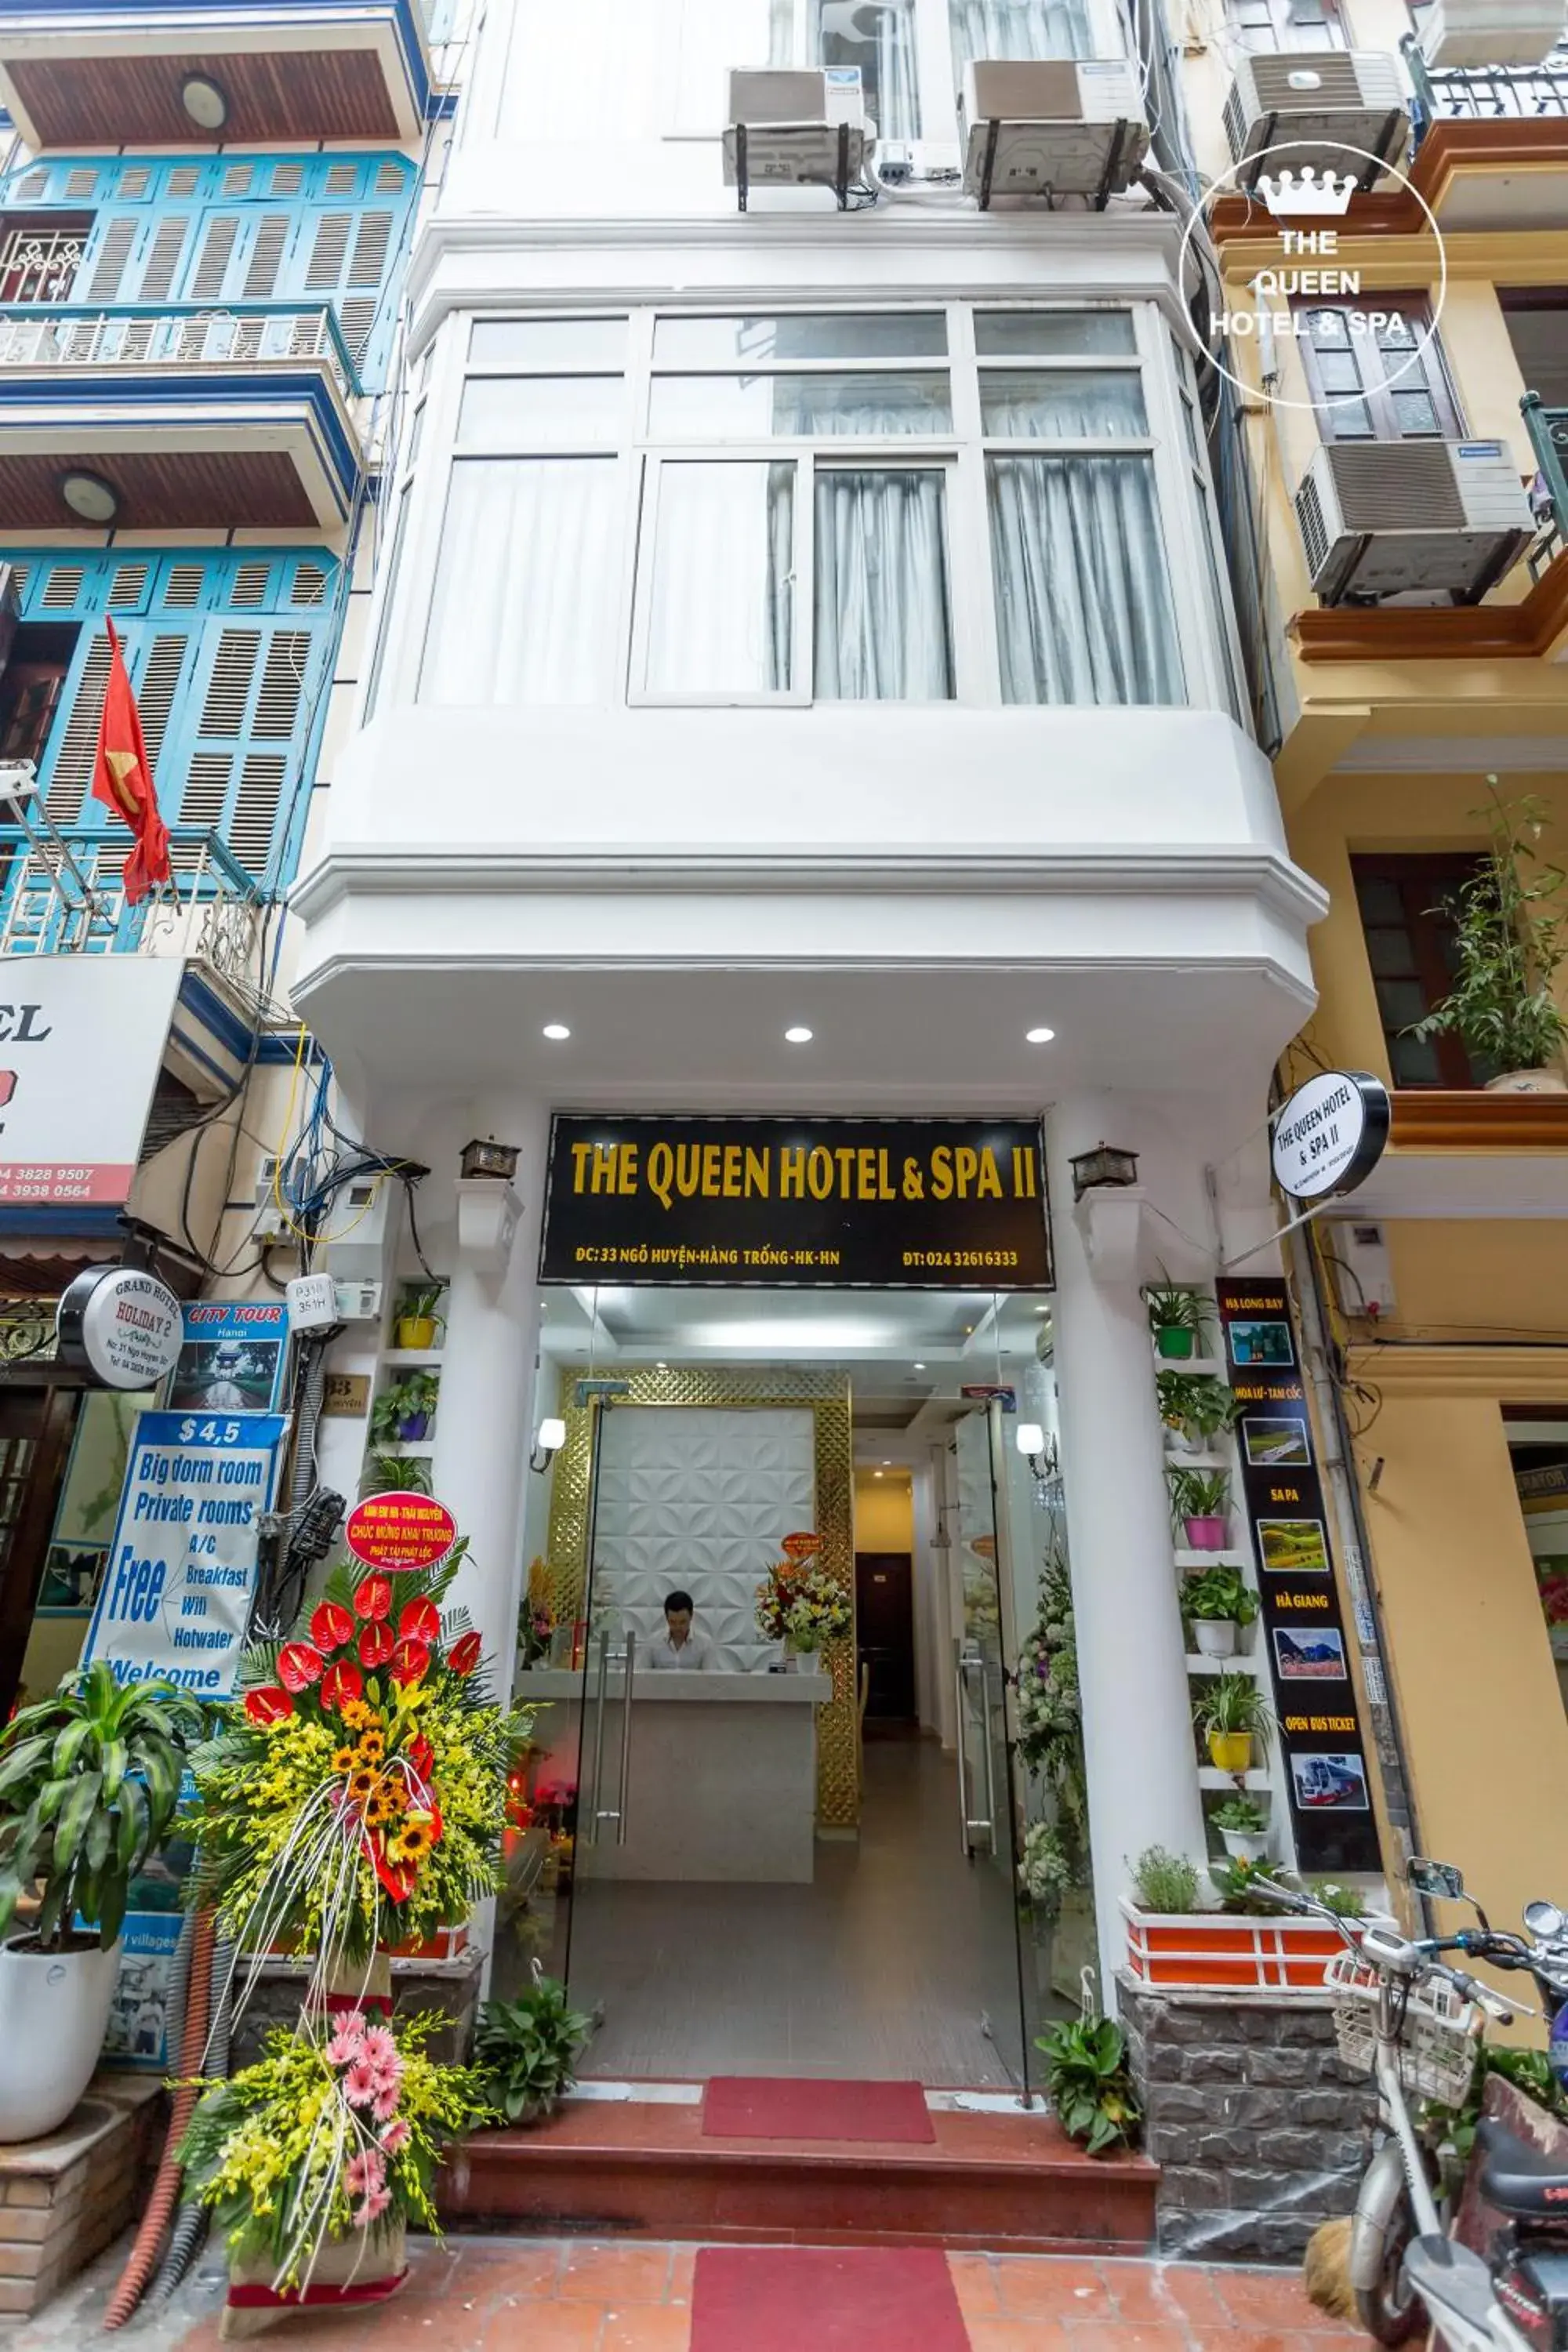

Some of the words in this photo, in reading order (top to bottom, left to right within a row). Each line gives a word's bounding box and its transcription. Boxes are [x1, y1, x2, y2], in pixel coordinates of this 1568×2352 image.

[1277, 1127, 1294, 1152] THE
[1294, 1106, 1323, 1142] QUEEN
[1321, 1085, 1352, 1119] HOTEL
[1299, 1149, 1308, 1166] &
[1308, 1133, 1330, 1160] SPA
[1330, 1123, 1340, 1145] II
[0, 1169, 12, 1180] 4
[571, 1142, 639, 1195] THE
[647, 1142, 769, 1211] QUEEN
[779, 1145, 897, 1200] HOTEL
[902, 1156, 925, 1200] &
[931, 1145, 1004, 1200] SPA
[1012, 1147, 1036, 1198] II
[619, 1244, 648, 1263] NGÕ
[115, 1279, 152, 1297] GRAND
[153, 1285, 179, 1320] HOTEL
[1240, 1298, 1263, 1309] LONG
[1265, 1298, 1284, 1309] BAY
[115, 1301, 164, 1334] HOLIDAY
[163, 1320, 172, 1338] 2
[187, 1306, 230, 1324] CITY
[234, 1305, 283, 1324] TOUR
[216, 1327, 248, 1338] Hanoi
[139, 1453, 169, 1485] Big
[172, 1455, 213, 1485] dorm
[216, 1460, 263, 1485] room
[134, 1492, 194, 1523] Private
[198, 1498, 253, 1525] rooms
[188, 1534, 216, 1554] A/C
[108, 1545, 167, 1623] Free
[186, 1564, 249, 1587] Breakfast
[1276, 1591, 1293, 1608] HÀ
[1293, 1595, 1329, 1608] GIANG
[173, 1627, 234, 1650] Hotwater
[1286, 1717, 1309, 1731] OPEN
[1310, 1717, 1328, 1732] BUS
[1328, 1717, 1356, 1732] TICKET
